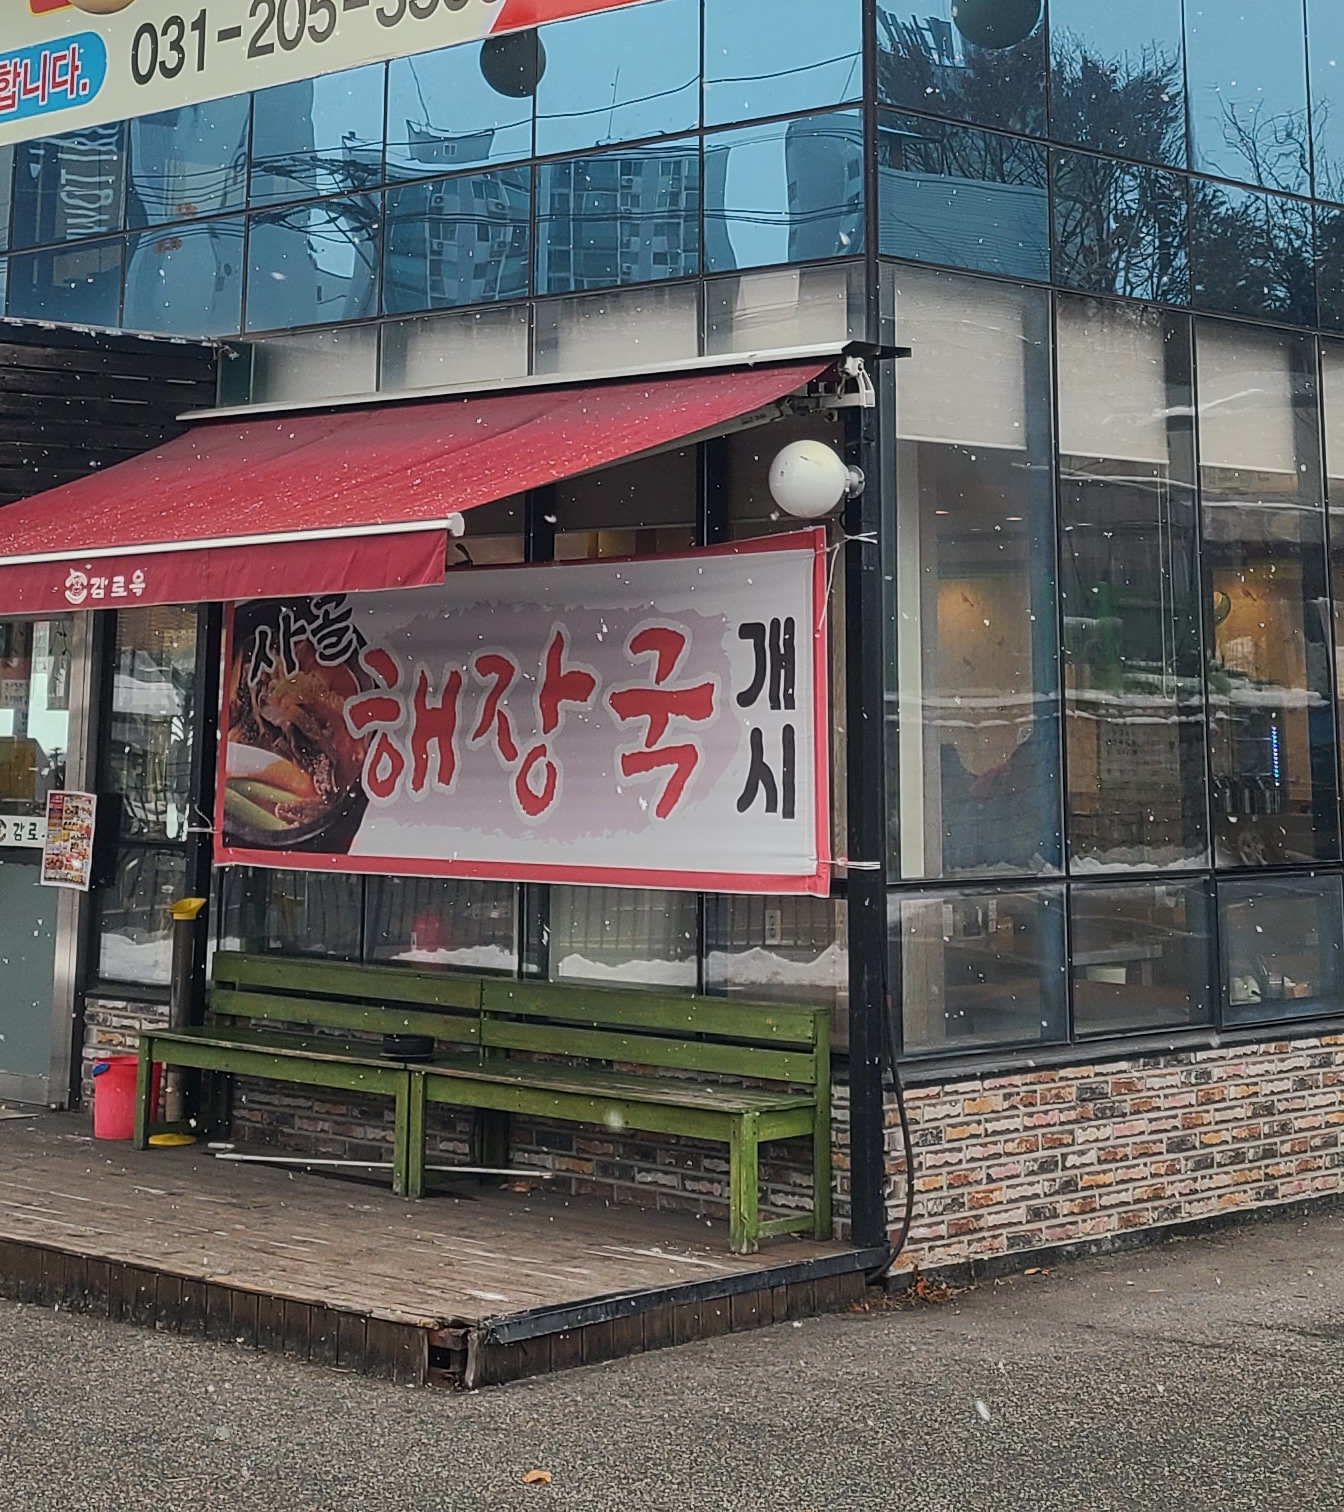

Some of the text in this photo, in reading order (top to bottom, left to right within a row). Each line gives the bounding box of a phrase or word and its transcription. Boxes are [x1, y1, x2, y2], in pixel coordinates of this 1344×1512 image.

[90, 569, 146, 598] 감로옥
[347, 628, 716, 821] 해장국
[737, 616, 796, 819] 개시
[13, 821, 46, 842] 감로
